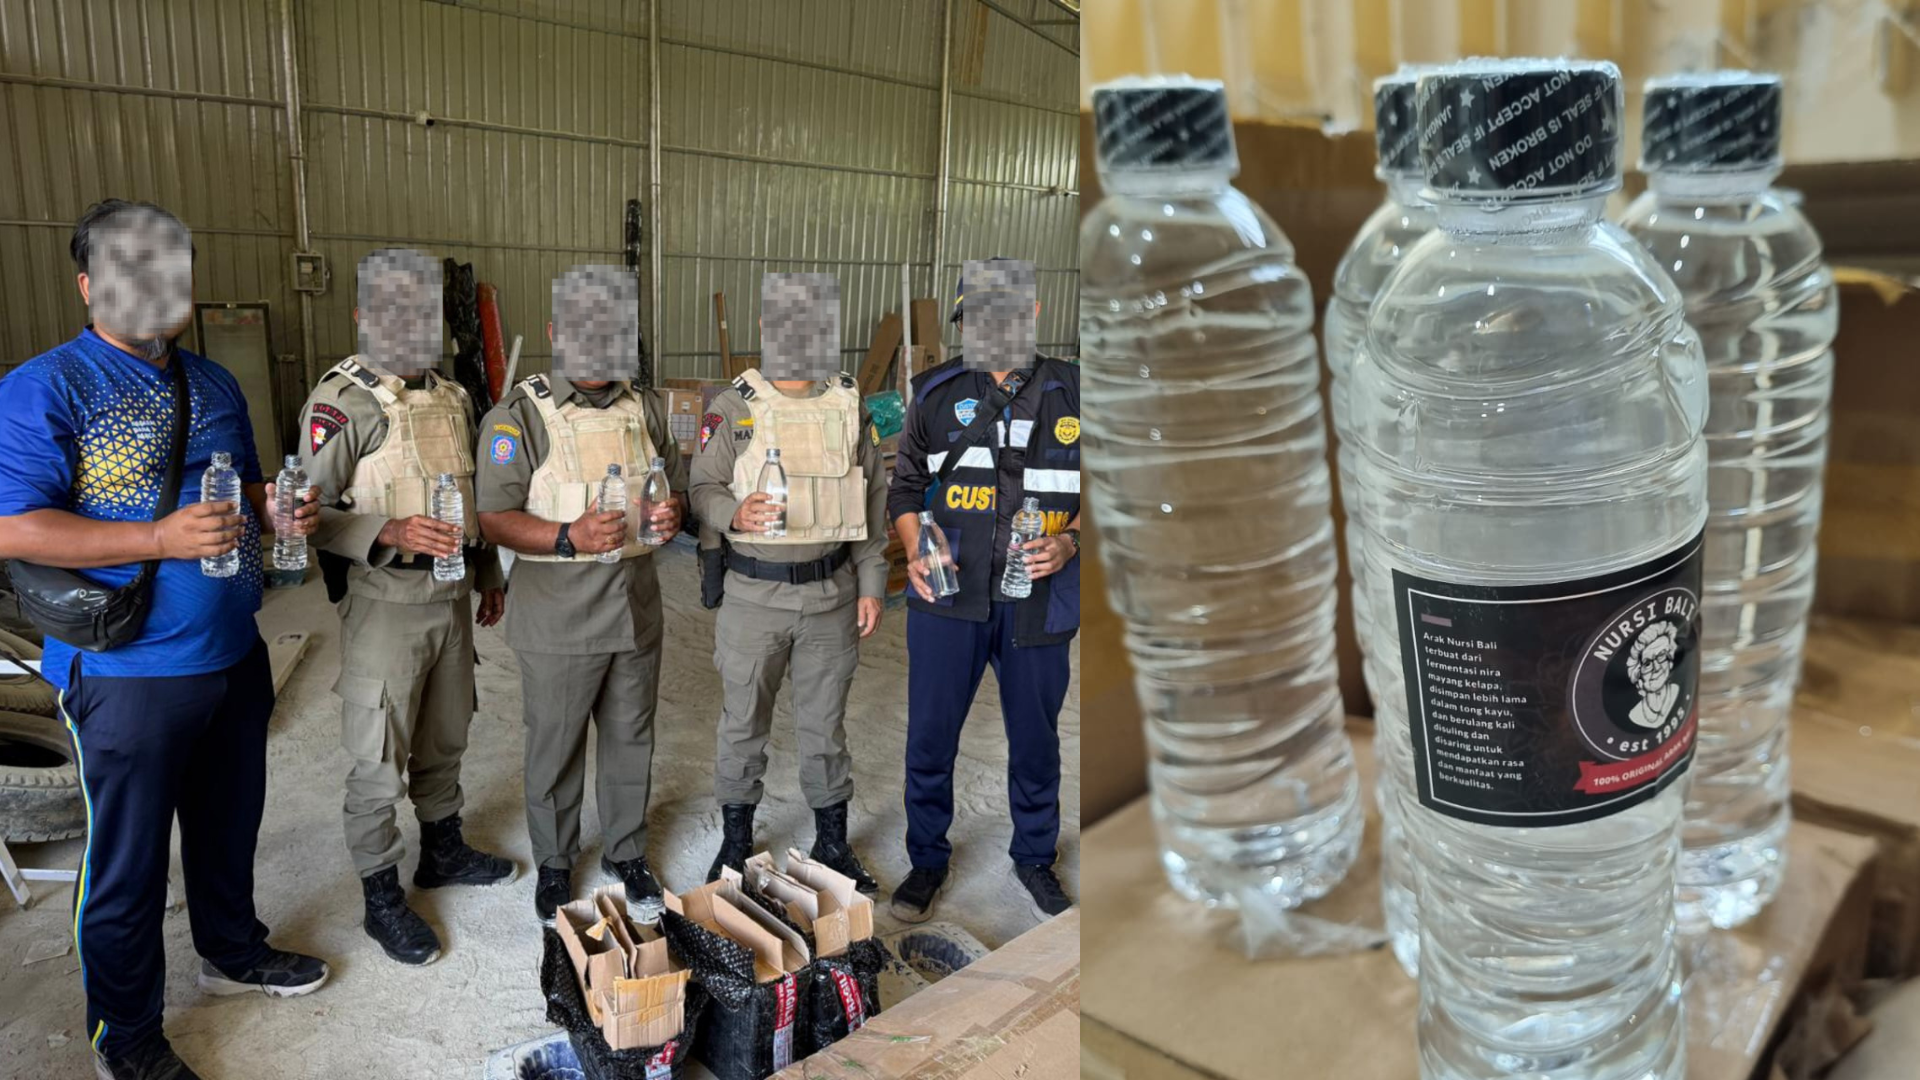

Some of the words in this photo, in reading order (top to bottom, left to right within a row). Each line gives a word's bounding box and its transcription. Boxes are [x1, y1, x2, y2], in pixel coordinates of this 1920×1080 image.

[1543, 69, 1572, 97] NOT
[1486, 86, 1540, 133] ACCEPT
[1562, 94, 1593, 122] SEAL
[1474, 124, 1486, 142] IF
[1547, 116, 1563, 135] IS
[1441, 133, 1472, 161] SEAL
[1488, 126, 1549, 172] BROKEN
[1575, 134, 1593, 155] DO
[1548, 148, 1575, 176] NOT
[1593, 602, 1657, 662] NURSI
[1664, 596, 1695, 621] BALI
[1423, 632, 1444, 644] Arak
[1447, 637, 1474, 648] Nursi
[1476, 640, 1497, 650] Bali
[1425, 646, 1459, 660] terbuat
[1461, 653, 1482, 662] dari
[1426, 658, 1477, 675] fermentasi
[1480, 667, 1501, 677] nira
[1428, 672, 1463, 688] mayang
[1429, 685, 1471, 700] disimpan
[1472, 692, 1499, 703] lebih
[1501, 695, 1527, 704] lama
[1430, 698, 1457, 711] dalam
[1459, 704, 1482, 716] tong
[1484, 707, 1513, 717] kayu,
[1432, 710, 1448, 721] dan
[1450, 714, 1494, 730] berulang
[1495, 720, 1515, 729] kali
[1619, 739, 1649, 752] est
[1655, 706, 1685, 744] 1995
[1433, 723, 1469, 739] disuling
[1471, 731, 1490, 740] dan
[1434, 735, 1471, 752] disaring
[1473, 745, 1503, 754] untuk
[1436, 748, 1500, 766] mendapatkan
[1437, 760, 1454, 771] dan
[1455, 765, 1495, 778] manfaat
[1497, 772, 1522, 781] yang
[1593, 775, 1620, 786] 100%
[1622, 758, 1663, 781] ORIGINAL
[1439, 771, 1494, 790] berkualitas.
